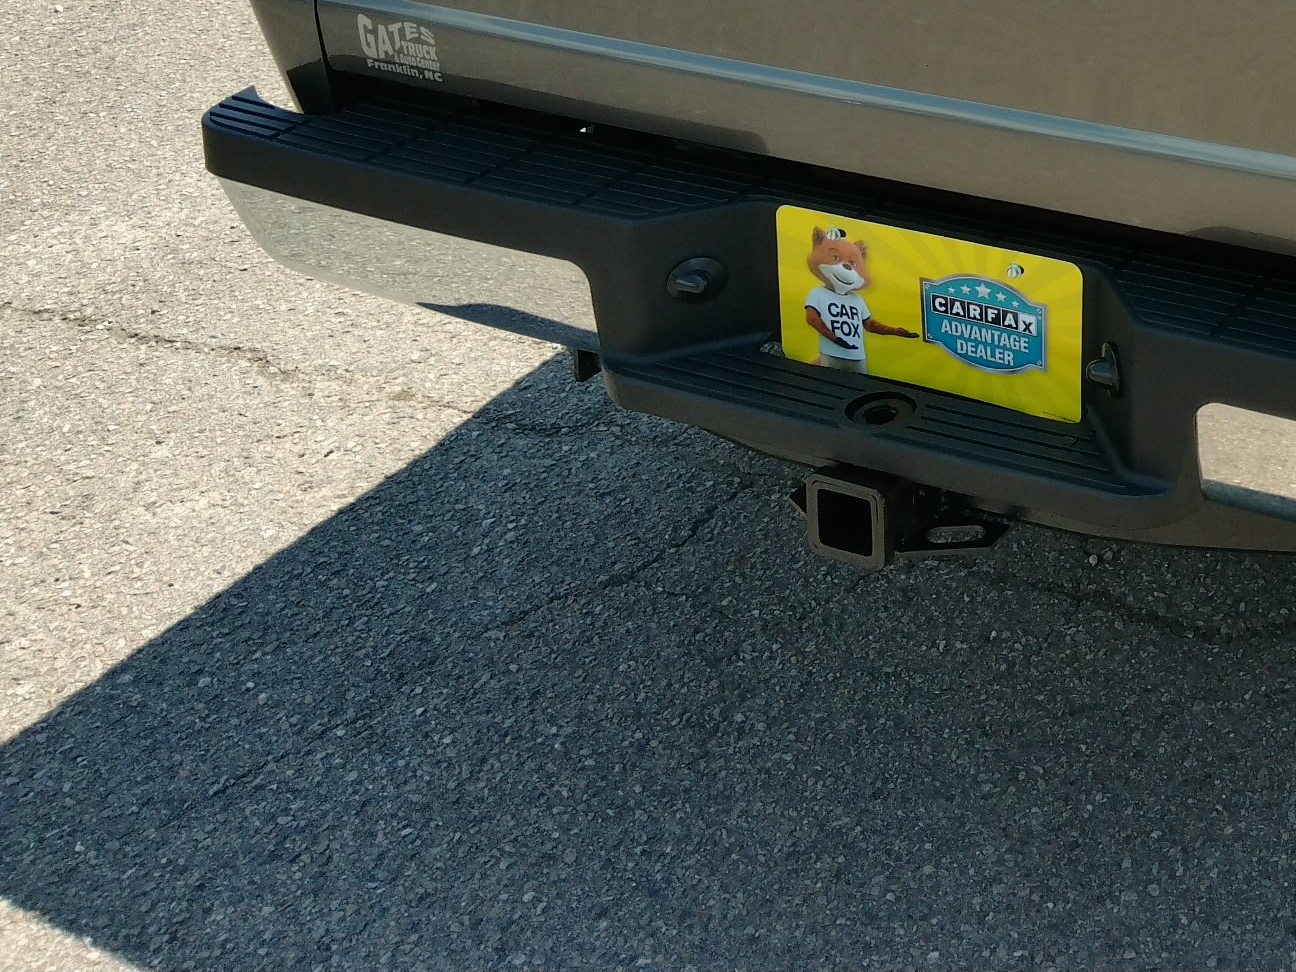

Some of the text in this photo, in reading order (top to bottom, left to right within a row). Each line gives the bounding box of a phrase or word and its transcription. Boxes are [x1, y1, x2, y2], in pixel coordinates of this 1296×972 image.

[357, 13, 435, 59] GATES
[401, 40, 438, 61] TRUCK
[366, 59, 443, 82] Franklin, NC
[400, 54, 417, 67] Auto
[417, 58, 440, 71] Center
[828, 302, 859, 320] CAR
[931, 295, 1037, 335] CARFAX
[830, 320, 861, 339] FOX
[941, 319, 1029, 353] ADVANTAGE
[956, 337, 1015, 367] DEALER
